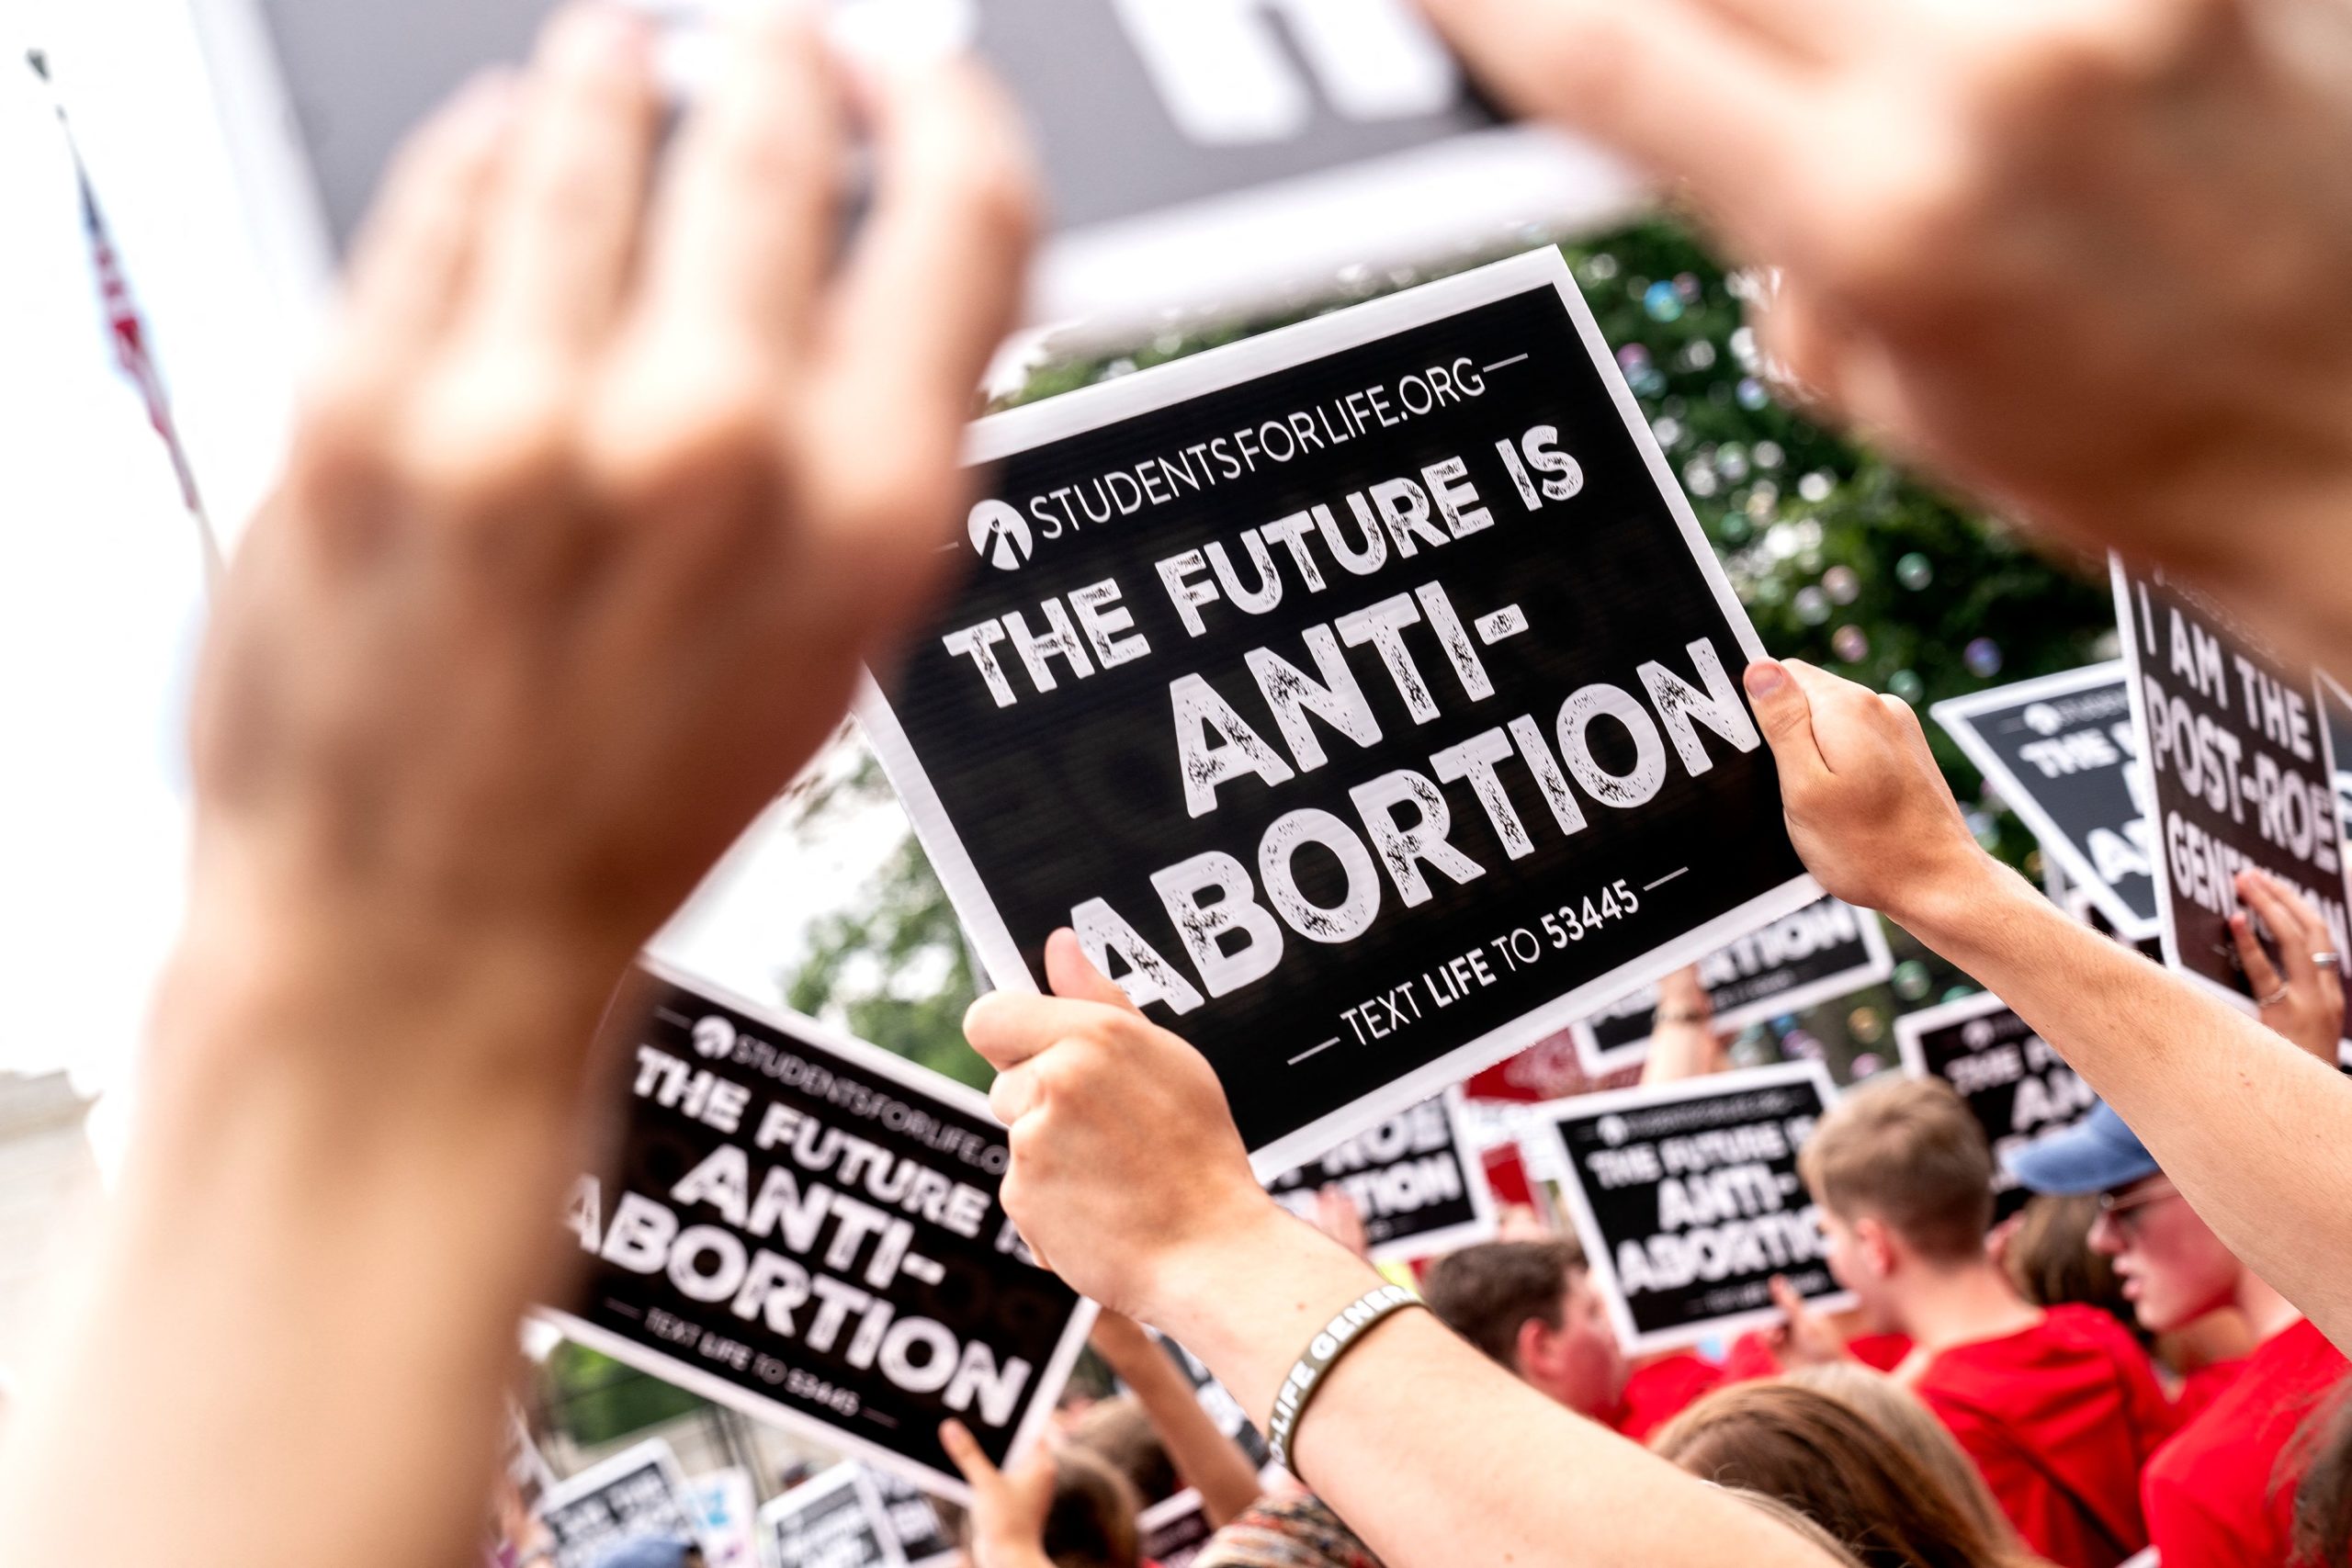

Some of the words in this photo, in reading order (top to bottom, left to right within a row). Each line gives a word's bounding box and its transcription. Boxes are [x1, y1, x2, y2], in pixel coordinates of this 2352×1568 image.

[1030, 355, 1486, 539] STUDENTSFORLIFE.ORG
[943, 578, 1151, 708] THE
[1154, 456, 1494, 638] FUTURE
[1496, 424, 1584, 512] IS
[1169, 580, 1529, 819] ANTI-
[2169, 607, 2228, 710] AM
[2234, 655, 2314, 762] THE
[1069, 637, 1760, 1017] ABORTION
[2143, 674, 2341, 875] POST-ROE
[1340, 982, 1421, 1046] TEXT
[1422, 950, 1496, 1009] LIFE
[1492, 929, 1540, 972] TO
[1540, 878, 1639, 949] 53445
[634, 1044, 752, 1133] THE
[755, 1101, 991, 1238] FUTURE
[732, 1034, 1010, 1175] STUDENTSFORLIFE.O
[1585, 1142, 1663, 1190] THE
[670, 1144, 944, 1288] ANTI-
[1657, 1161, 1799, 1232] ANTI-
[562, 1173, 1031, 1427] ABORTION
[1269, 1360, 1316, 1465] O-LIFE
